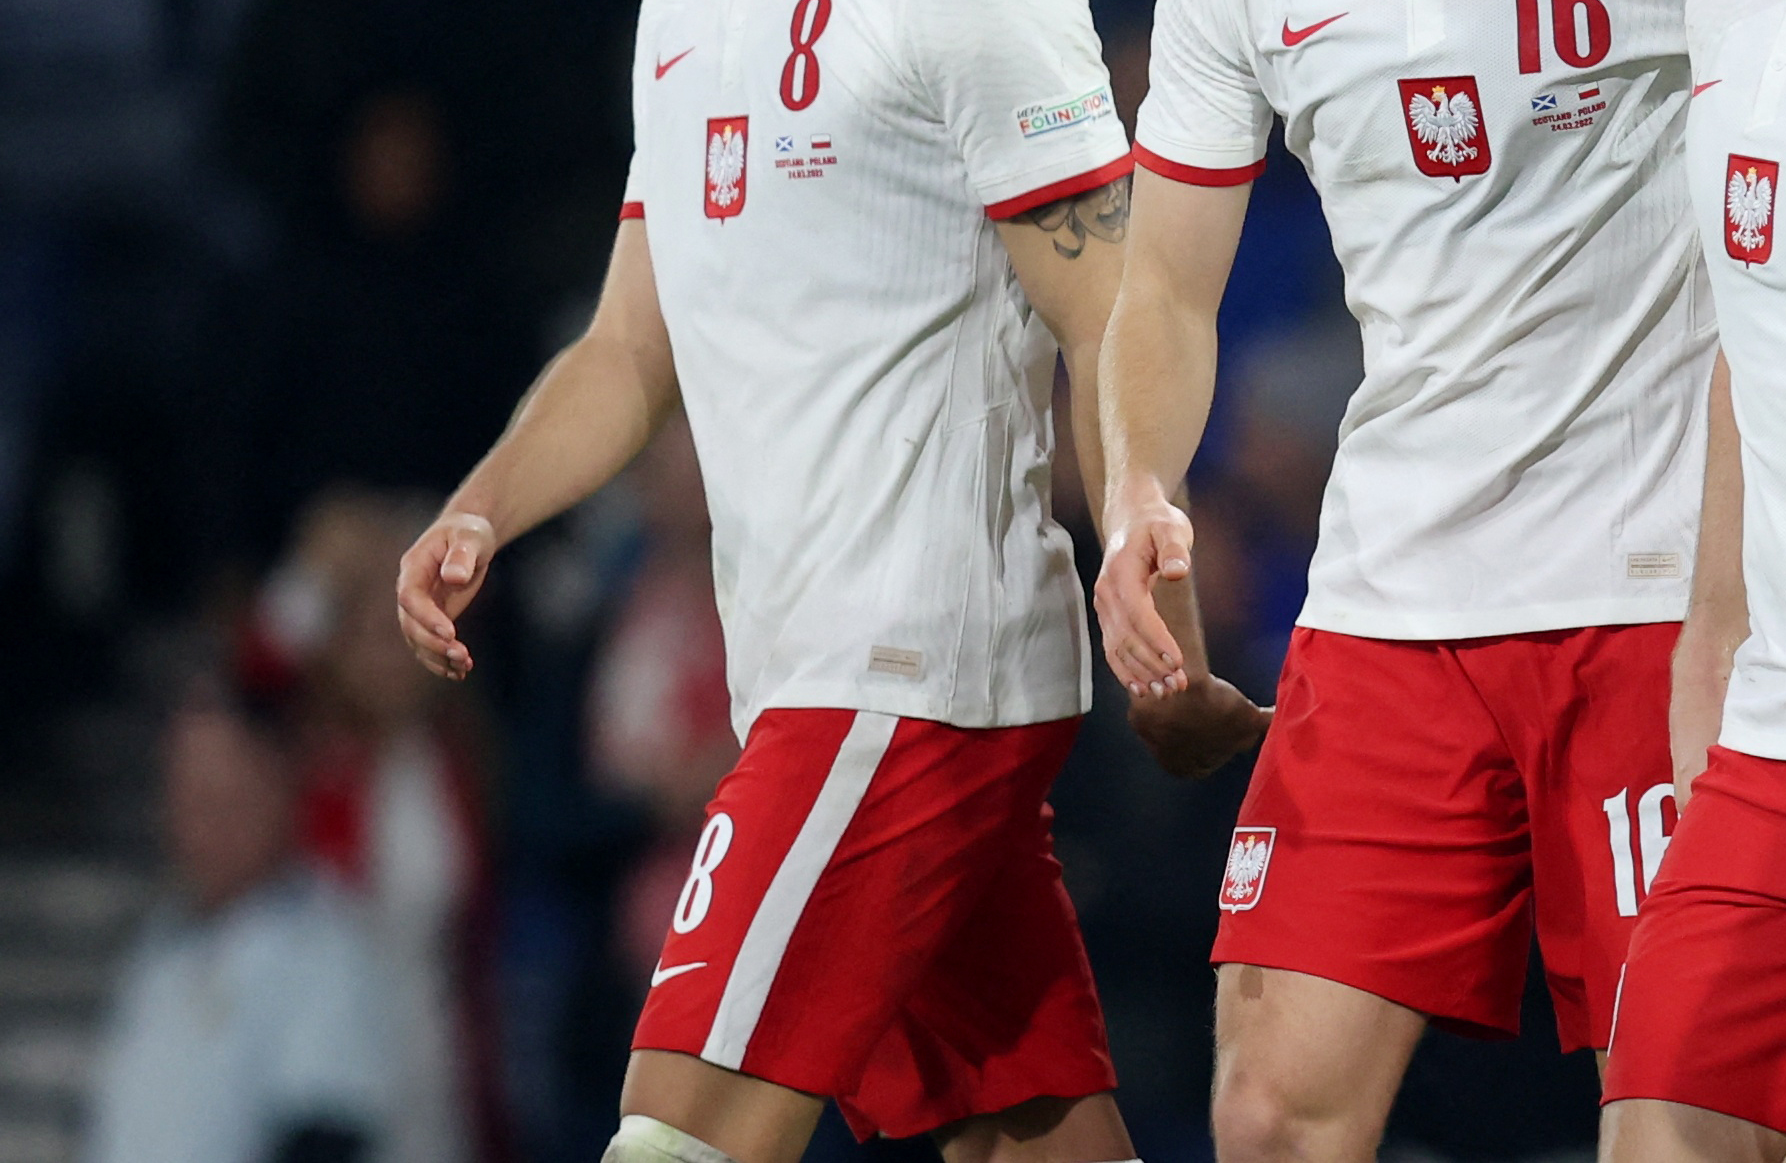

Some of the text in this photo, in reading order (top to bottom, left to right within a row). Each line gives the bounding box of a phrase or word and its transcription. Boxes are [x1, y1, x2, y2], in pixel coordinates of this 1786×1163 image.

[1017, 104, 1043, 119] UEFA
[1532, 112, 1572, 126] SCOTLAND
[1578, 101, 1606, 116] POLAND
[673, 812, 734, 935] 8
